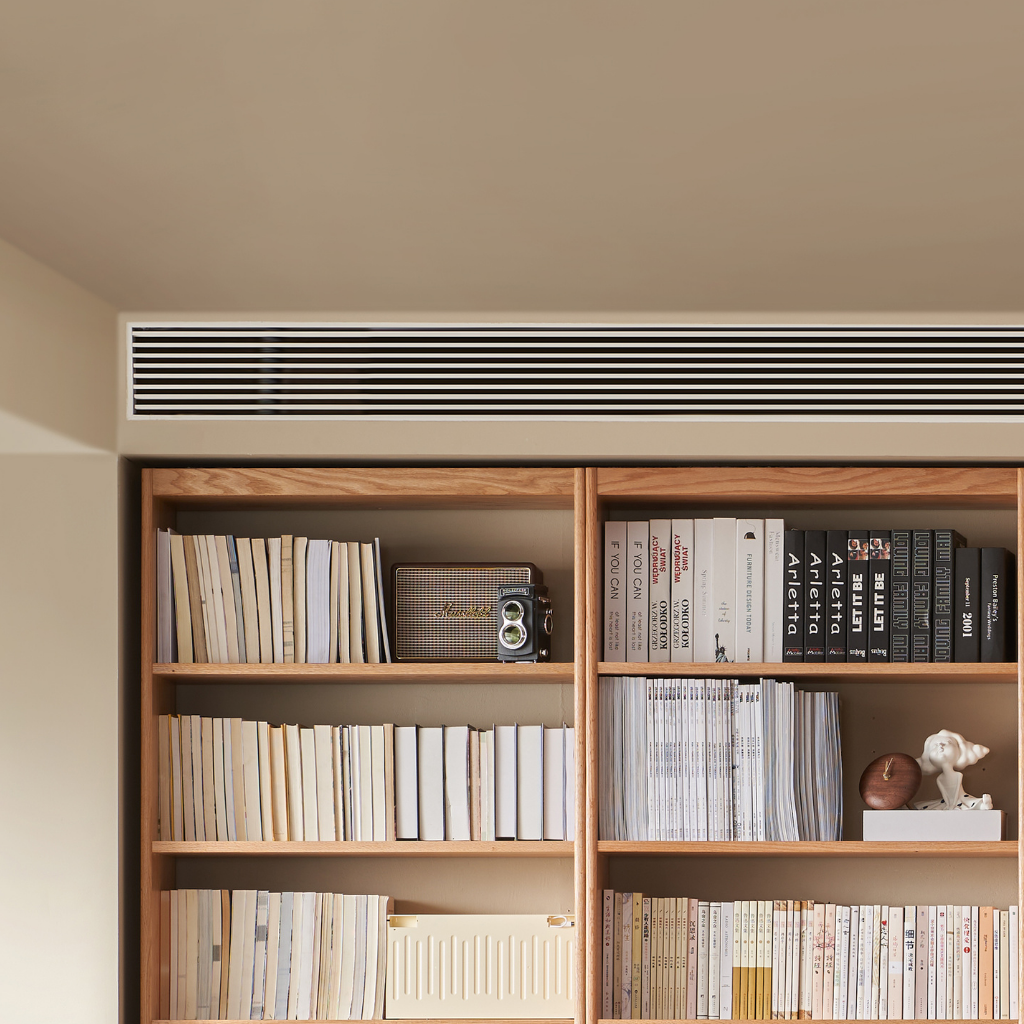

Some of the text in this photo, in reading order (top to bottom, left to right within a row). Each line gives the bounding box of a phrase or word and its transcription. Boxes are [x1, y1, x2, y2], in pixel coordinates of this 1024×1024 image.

[611, 540, 619, 600] IF YOU CAN
[634, 540, 642, 600] IF YOU CAN
[788, 552, 801, 635] Arletta
[809, 552, 823, 635] Arletta
[831, 552, 844, 635] Arletta
[852, 573, 862, 632] LET IT BE
[874, 573, 884, 631] LET IT BE
[963, 612, 972, 637] 2001
